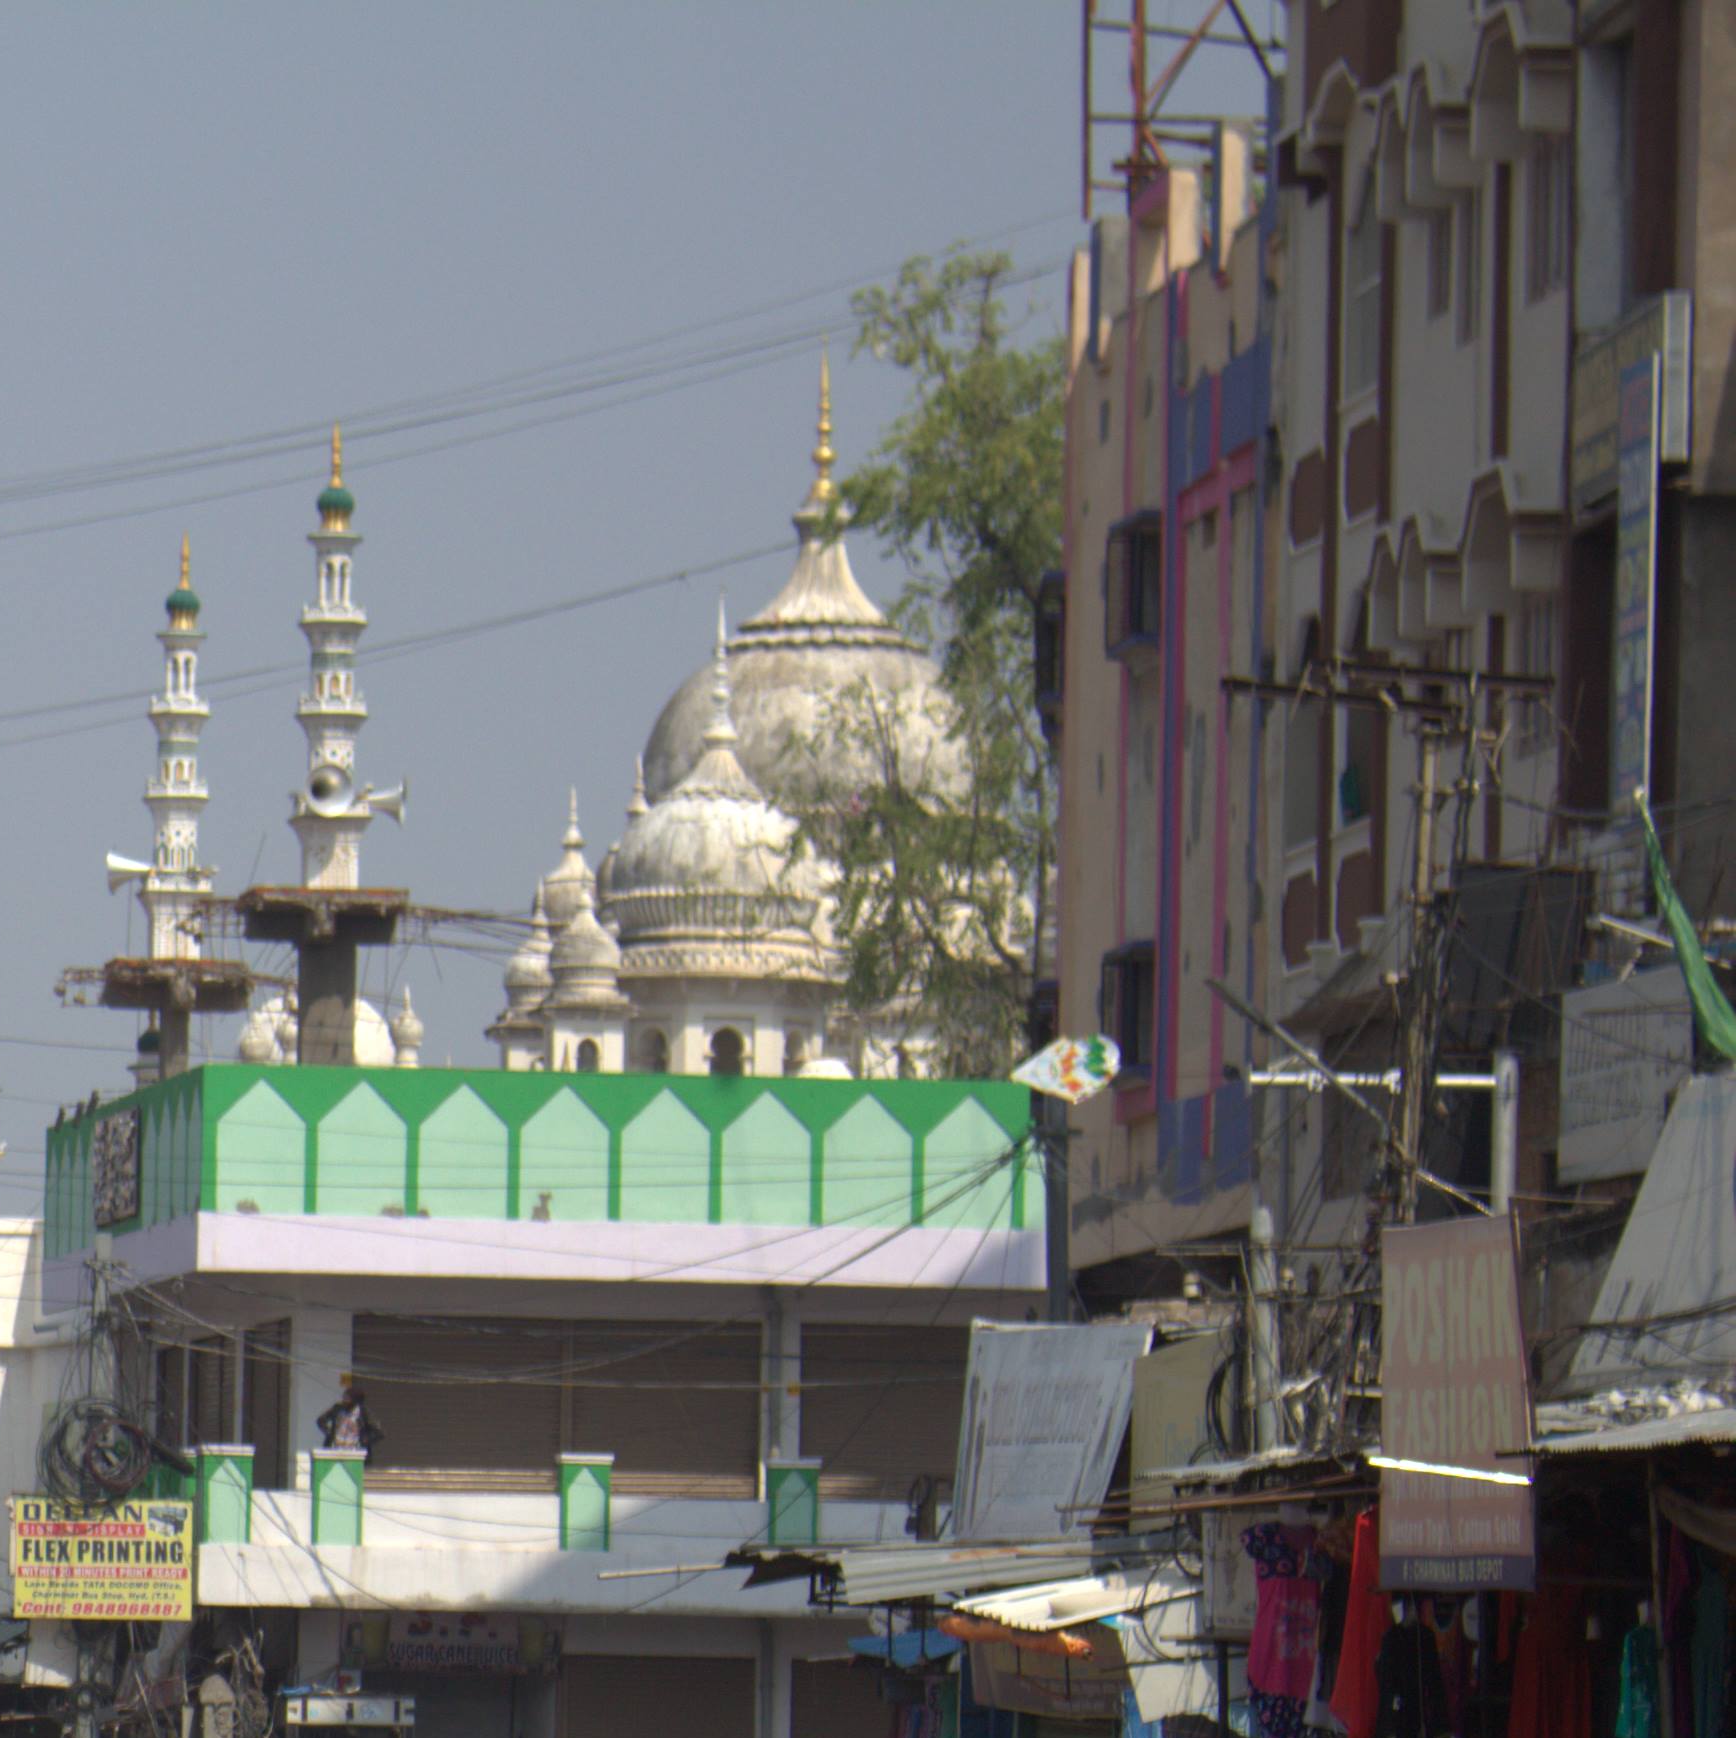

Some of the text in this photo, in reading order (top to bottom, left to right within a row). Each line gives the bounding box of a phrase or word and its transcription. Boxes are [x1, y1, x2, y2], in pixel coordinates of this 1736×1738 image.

[1387, 1381, 1514, 1458] FASHION
[22, 1539, 183, 1563] FLEX PRINTING
[1476, 1559, 1503, 1582] DEPOT
